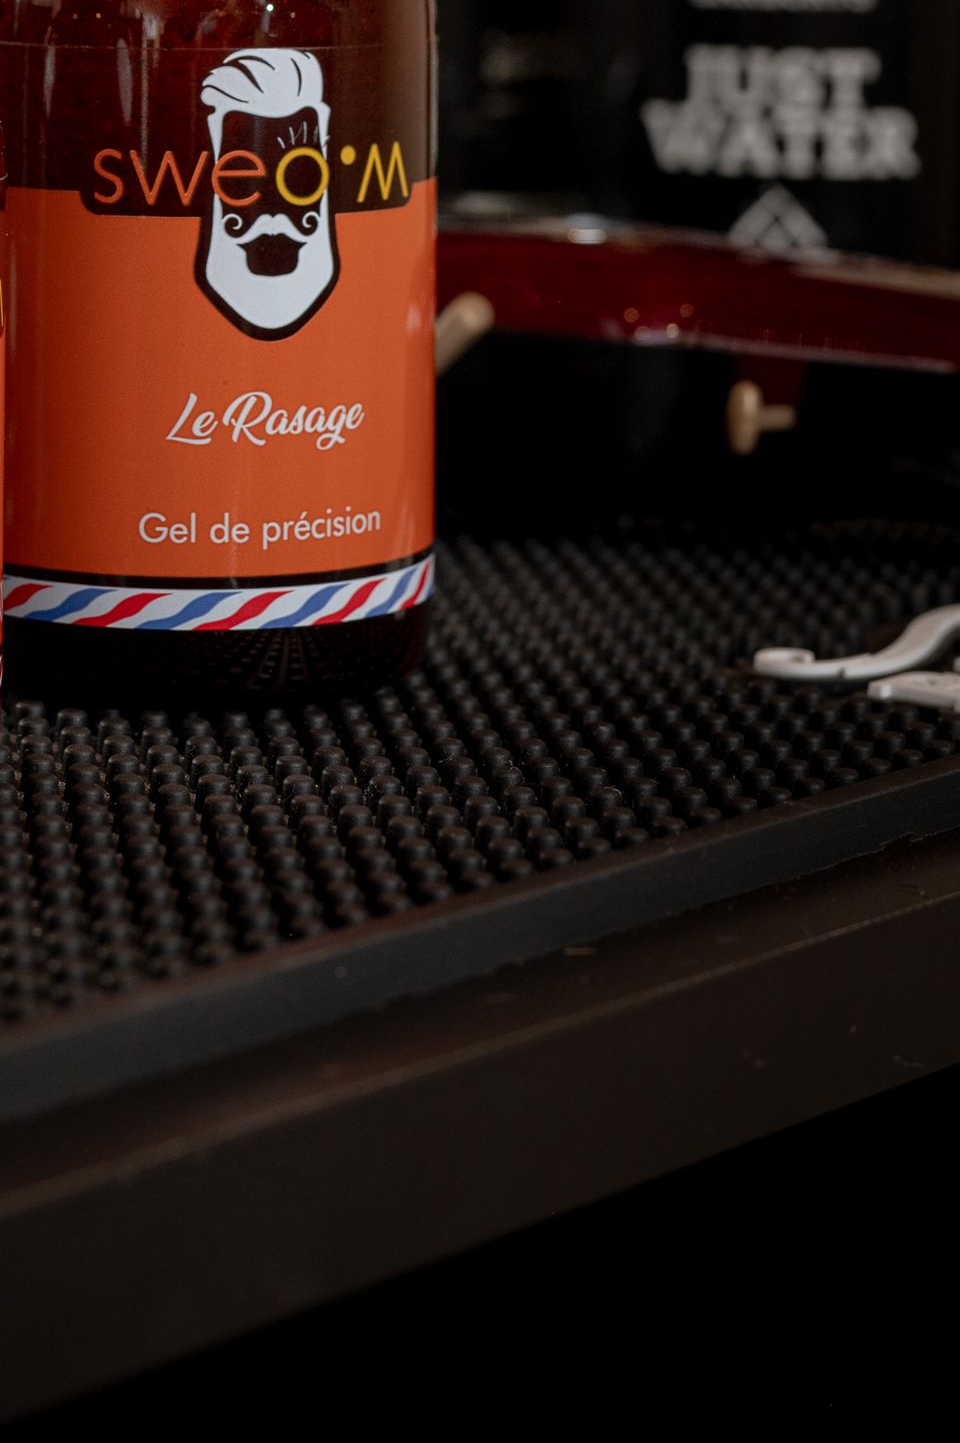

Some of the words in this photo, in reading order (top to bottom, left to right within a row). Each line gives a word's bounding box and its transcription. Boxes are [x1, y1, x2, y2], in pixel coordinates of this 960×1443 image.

[641, 99, 921, 181] WATER
[166, 392, 218, 445] Le
[222, 390, 365, 450] Rasage
[139, 512, 197, 544] Gel
[209, 512, 250, 544] de
[262, 506, 381, 550] précision
